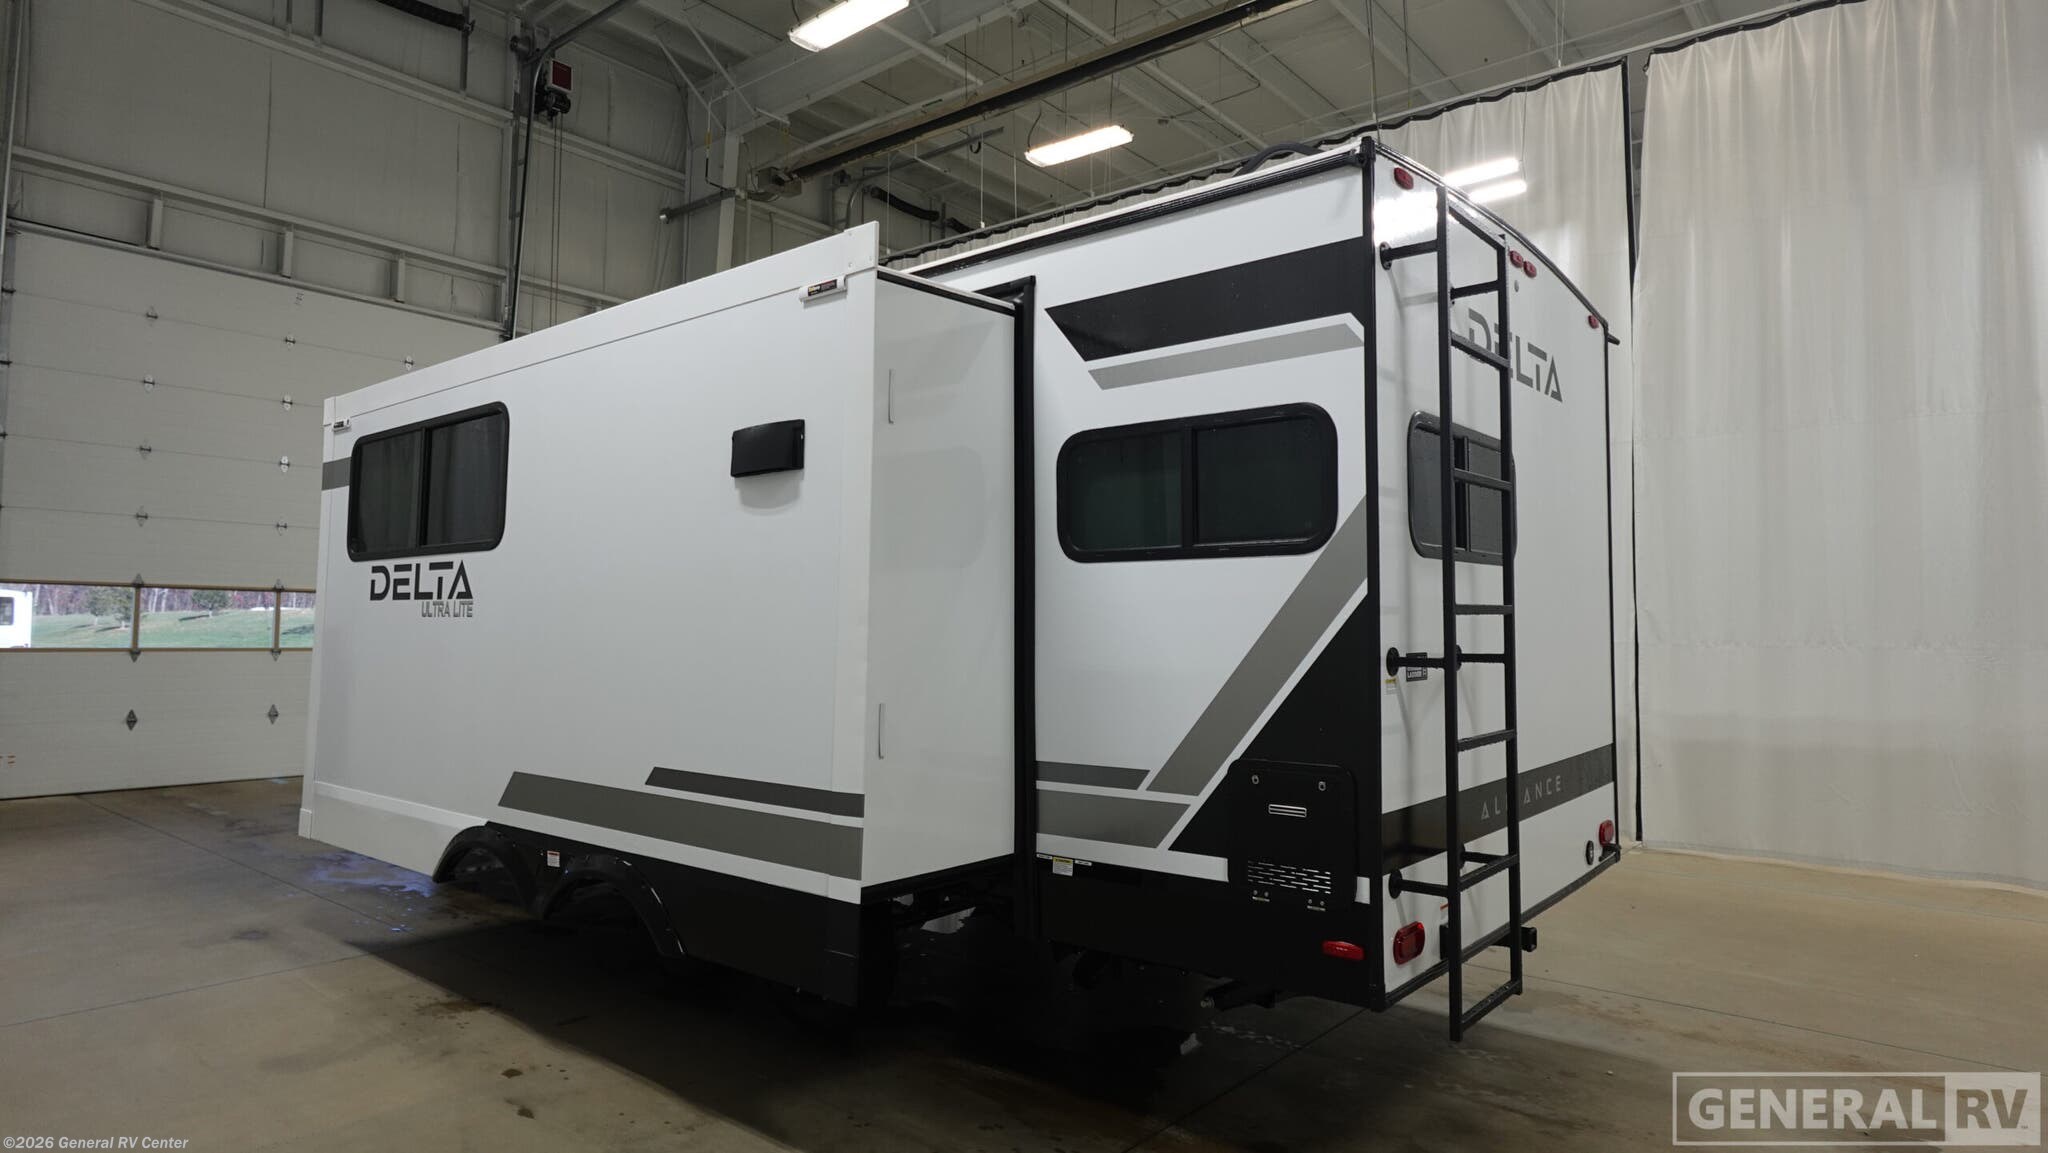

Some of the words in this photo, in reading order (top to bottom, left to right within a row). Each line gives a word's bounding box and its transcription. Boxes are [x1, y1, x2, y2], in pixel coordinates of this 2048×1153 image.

[370, 560, 473, 601] DELTA
[421, 601, 451, 618] ULTRA
[453, 601, 473, 618] LITE
[1481, 775, 1561, 820] ALANCE
